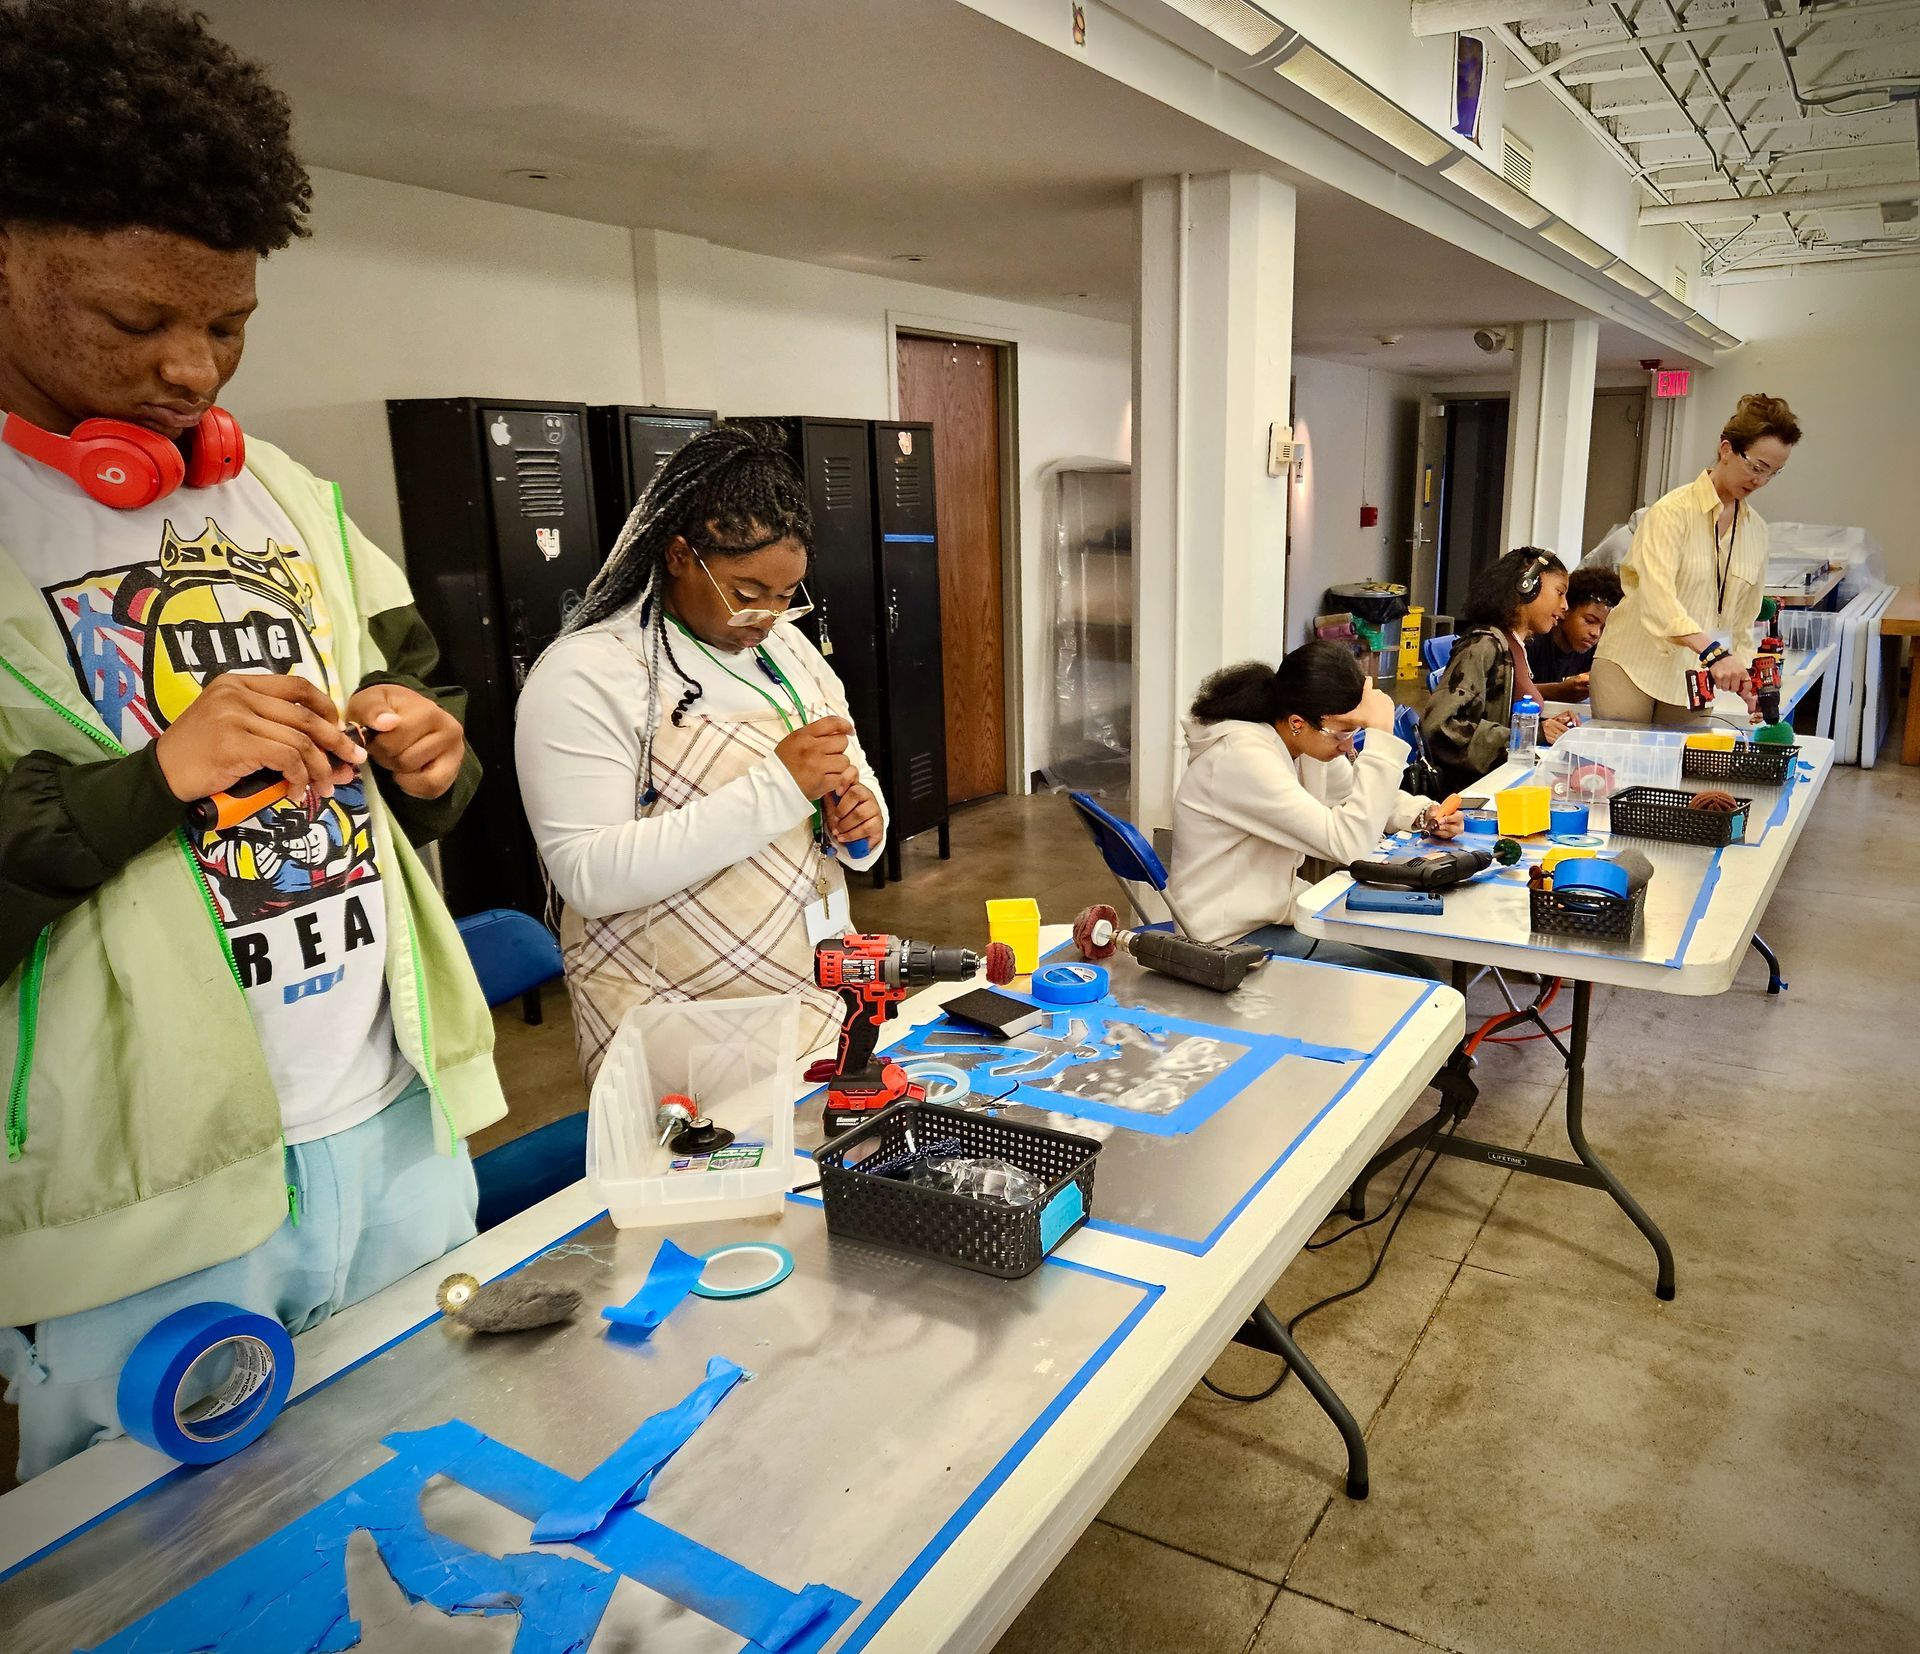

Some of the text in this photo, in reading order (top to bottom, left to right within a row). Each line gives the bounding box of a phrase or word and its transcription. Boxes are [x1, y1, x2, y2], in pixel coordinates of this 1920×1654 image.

[1657, 370, 1690, 397] EXIT
[174, 624, 292, 666] KING
[1492, 1153, 1522, 1165] LIFETIME
